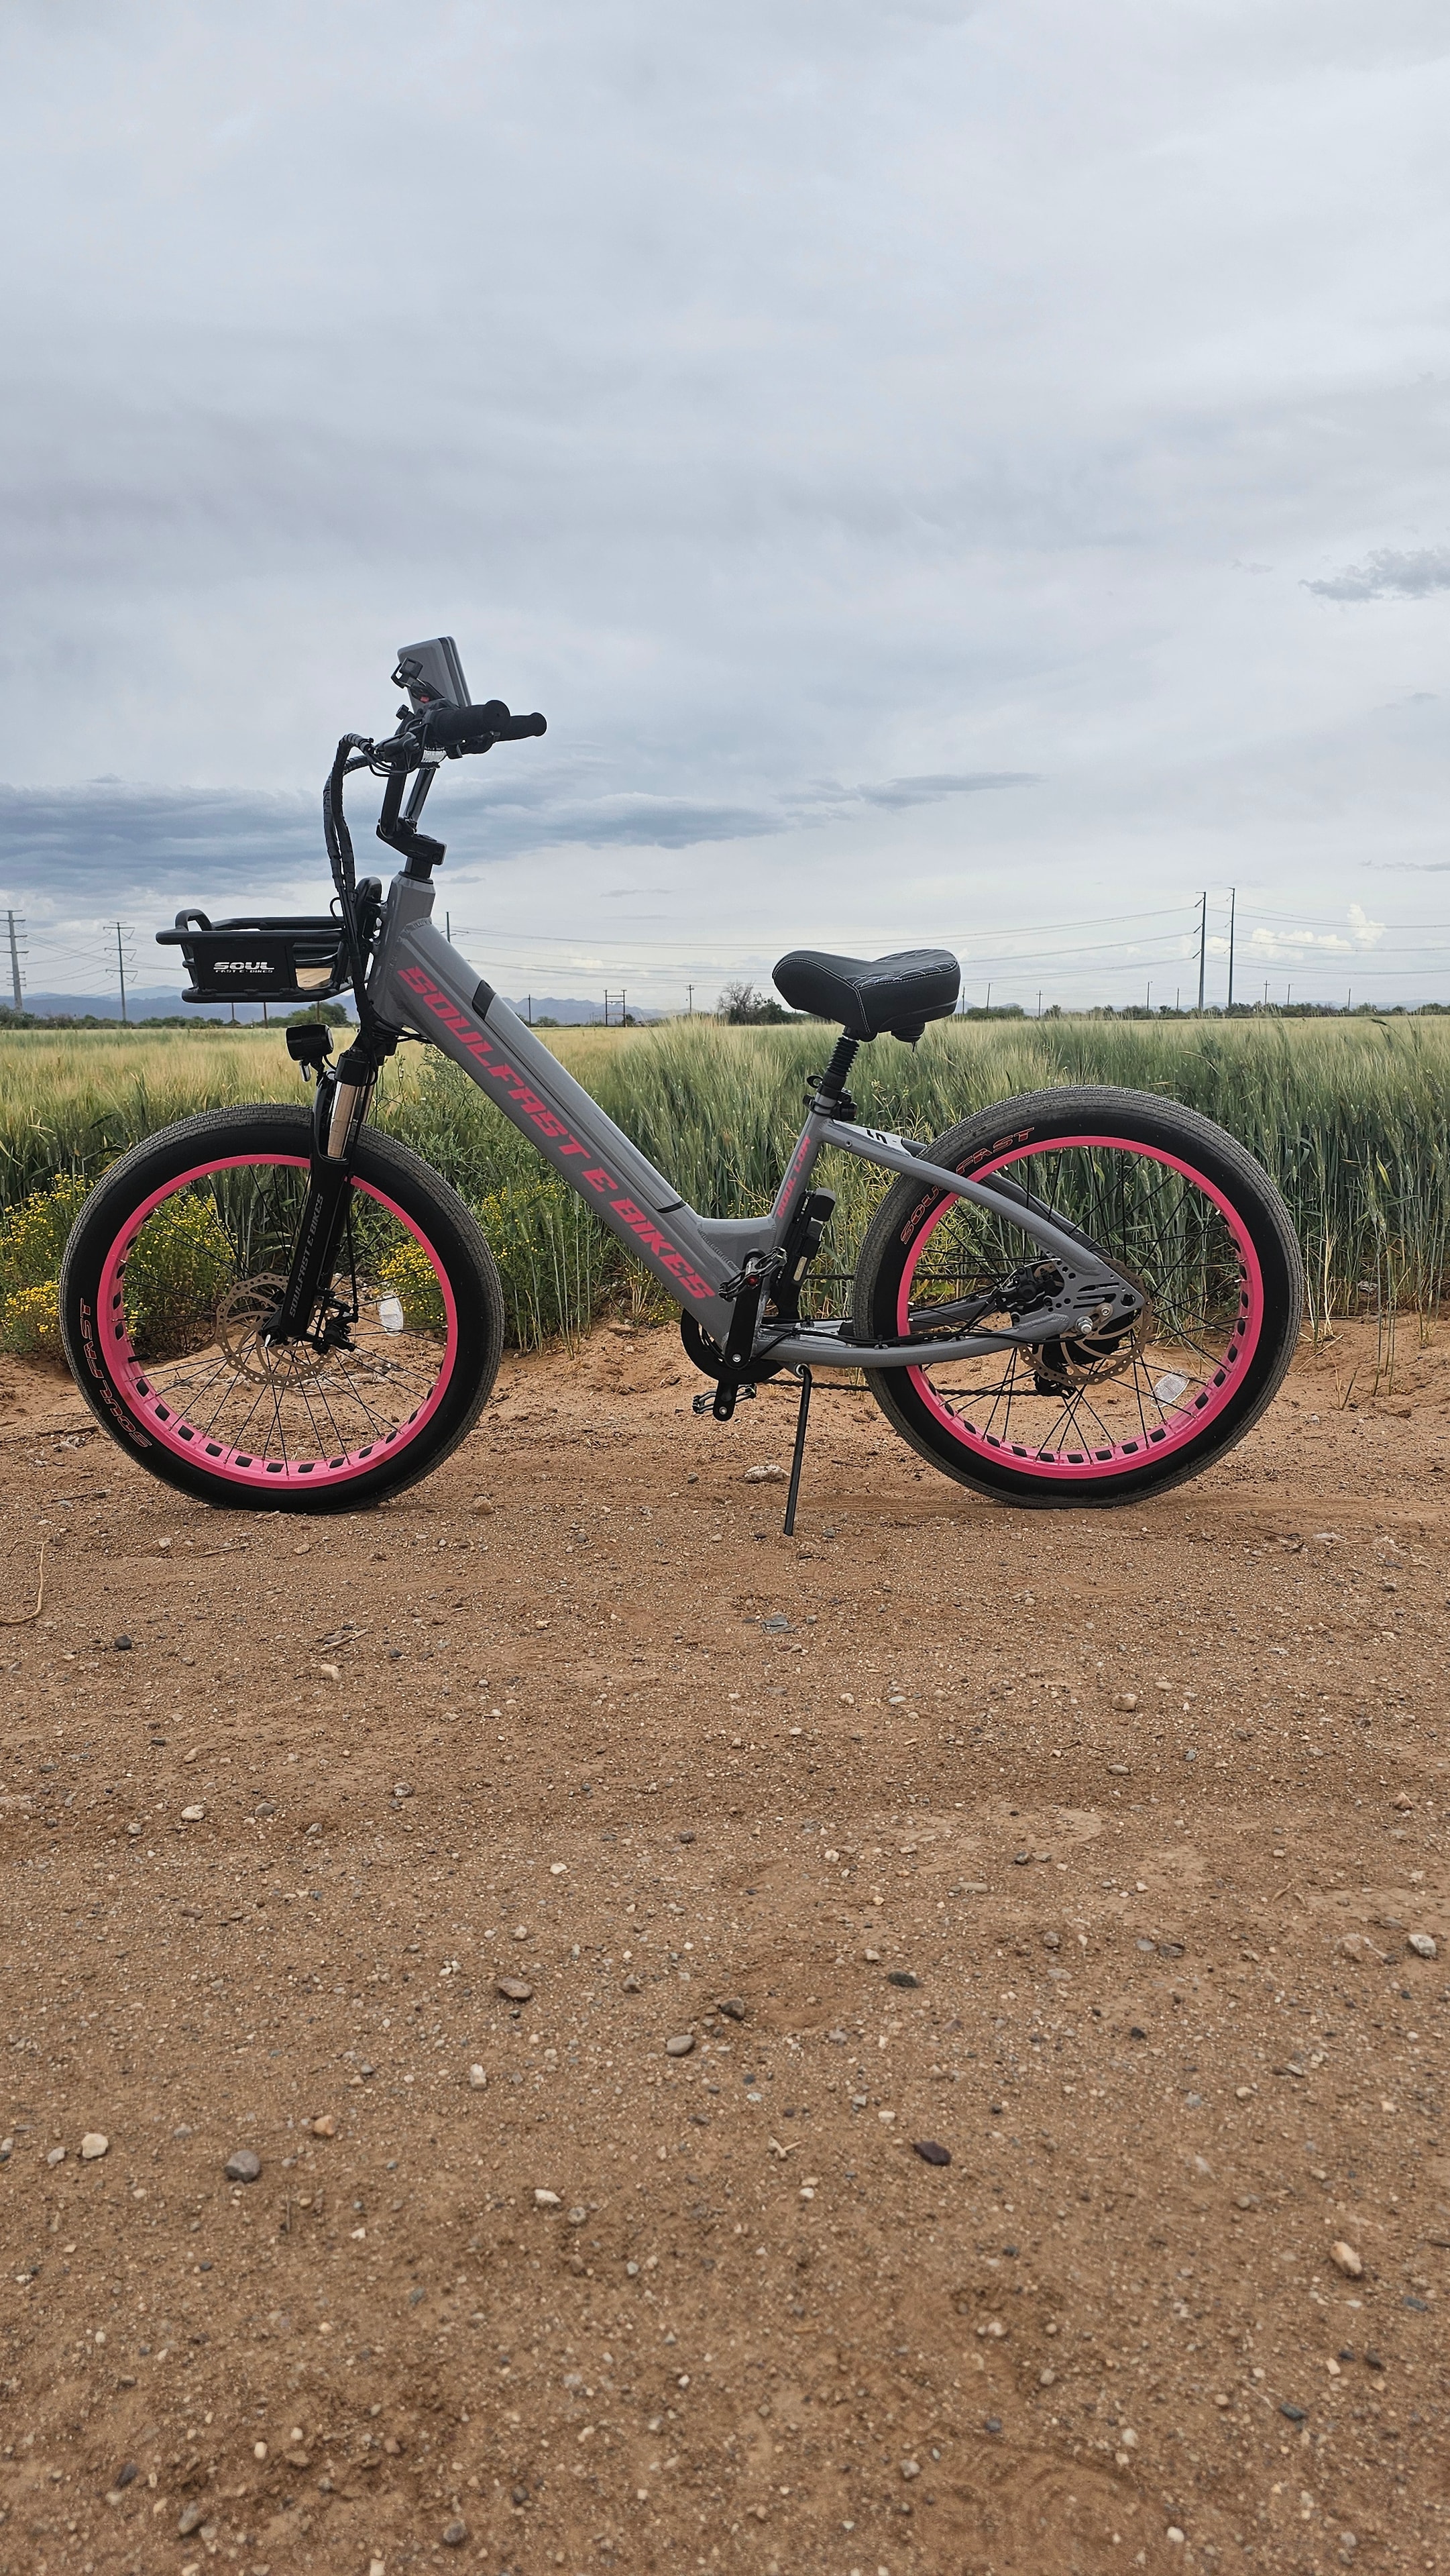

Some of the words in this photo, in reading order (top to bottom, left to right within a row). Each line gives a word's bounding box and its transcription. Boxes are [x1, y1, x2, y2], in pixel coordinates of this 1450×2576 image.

[213, 961, 275, 970] SOUL
[309, 1193, 324, 1236] BIKES
[900, 1185, 945, 1245] SOU
[956, 1127, 1035, 1175] FAST
[306, 1235, 314, 1247] E
[582, 1167, 618, 1193] E
[610, 1197, 716, 1299] BIKES
[80, 1297, 105, 1379] FAST
[99, 1379, 153, 1448] SOUL
